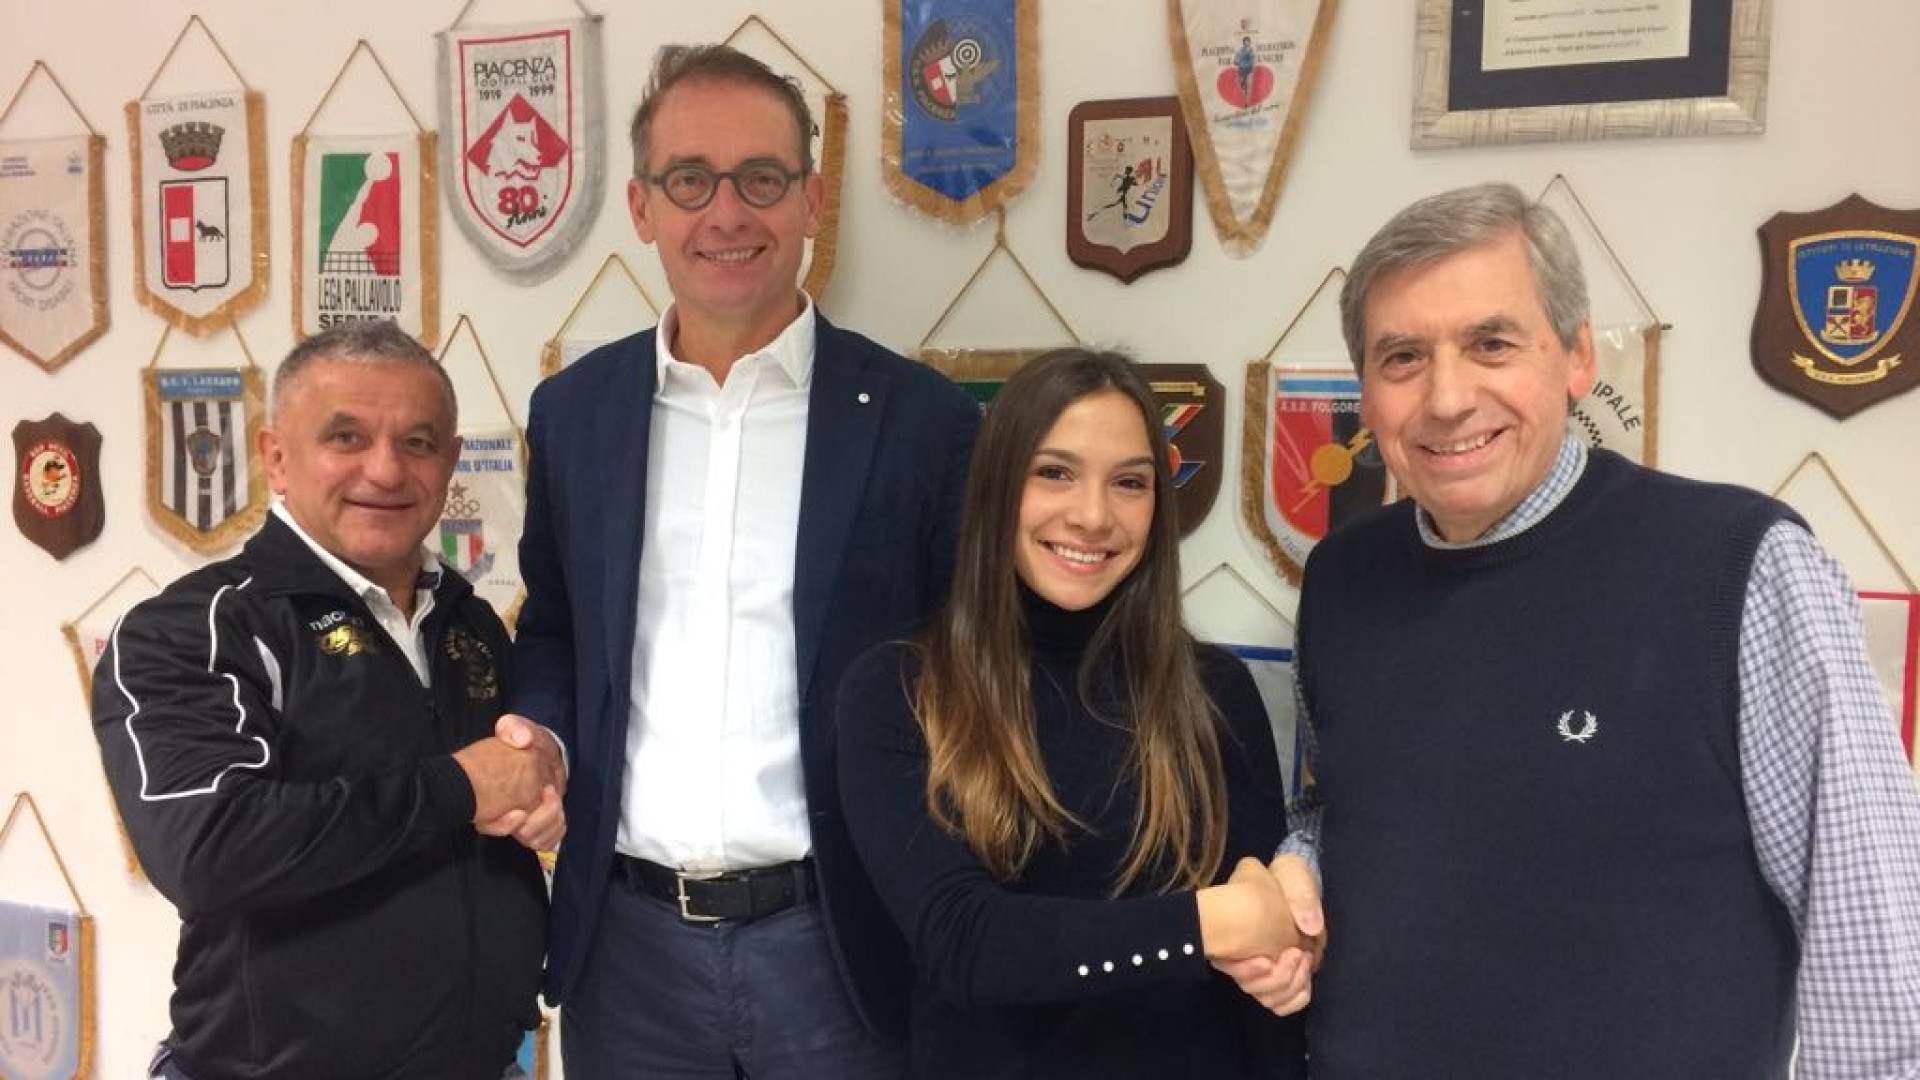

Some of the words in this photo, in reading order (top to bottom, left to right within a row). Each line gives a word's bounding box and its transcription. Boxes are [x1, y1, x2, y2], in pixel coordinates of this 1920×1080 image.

[474, 56, 556, 87] PIACENZA
[498, 185, 539, 216] 80
[318, 278, 342, 311] LEGA
[344, 278, 402, 312] PALLAVOLO
[1310, 400, 1362, 414] FOLGORE
